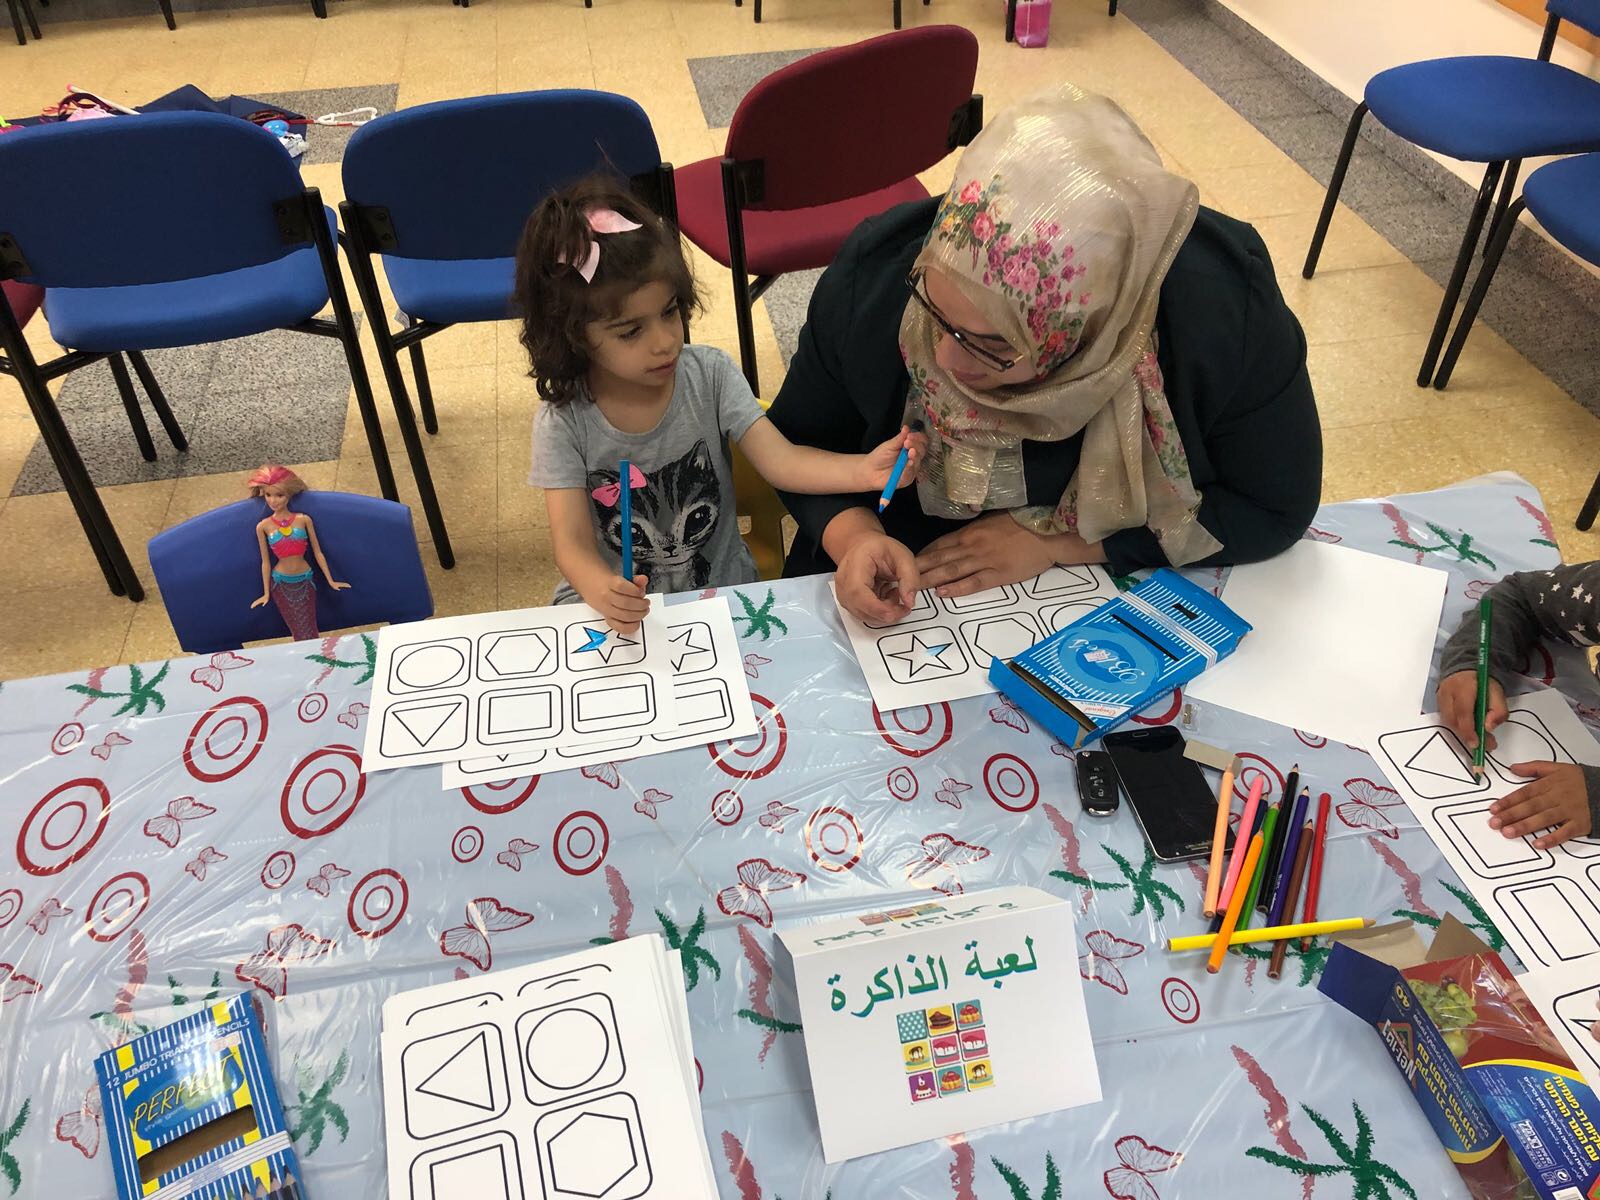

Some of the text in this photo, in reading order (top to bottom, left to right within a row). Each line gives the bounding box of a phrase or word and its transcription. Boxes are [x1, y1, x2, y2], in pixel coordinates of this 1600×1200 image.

[827, 935, 1038, 1018] لعبة الذاكرة
[106, 1078, 120, 1089] 12
[124, 1058, 157, 1081] JUMBO
[209, 1018, 250, 1038] PENCILS
[133, 1053, 236, 1131] PERFECT
[1544, 1078, 1600, 1162] עם הסגר ההרמטי
[1554, 1076, 1580, 1109] פעמיות
[1575, 1108, 1585, 1121] רב
